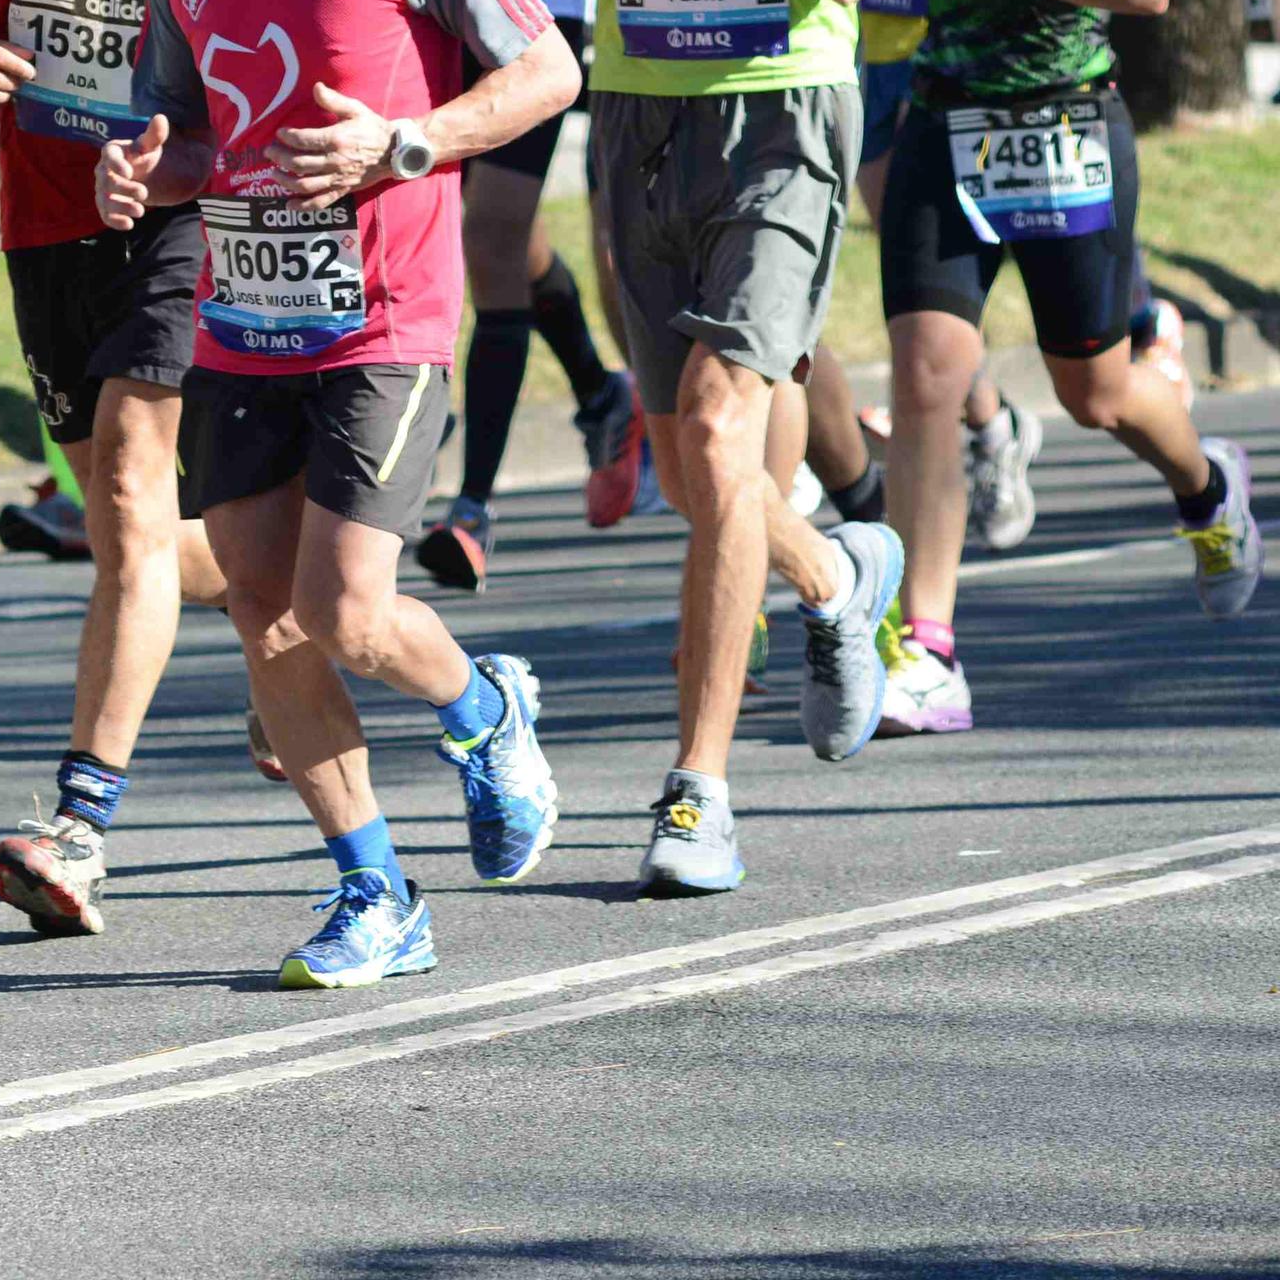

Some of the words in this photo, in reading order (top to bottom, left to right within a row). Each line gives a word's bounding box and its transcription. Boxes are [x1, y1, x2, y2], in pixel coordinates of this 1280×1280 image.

[686, 30, 733, 47] IMQ
[66, 73, 97, 90] ADA
[71, 114, 109, 139] IMQ
[973, 128, 1087, 170] 14817
[221, 237, 342, 282] 16052
[265, 293, 328, 308] MIGUEL
[260, 334, 304, 349] IMQ
